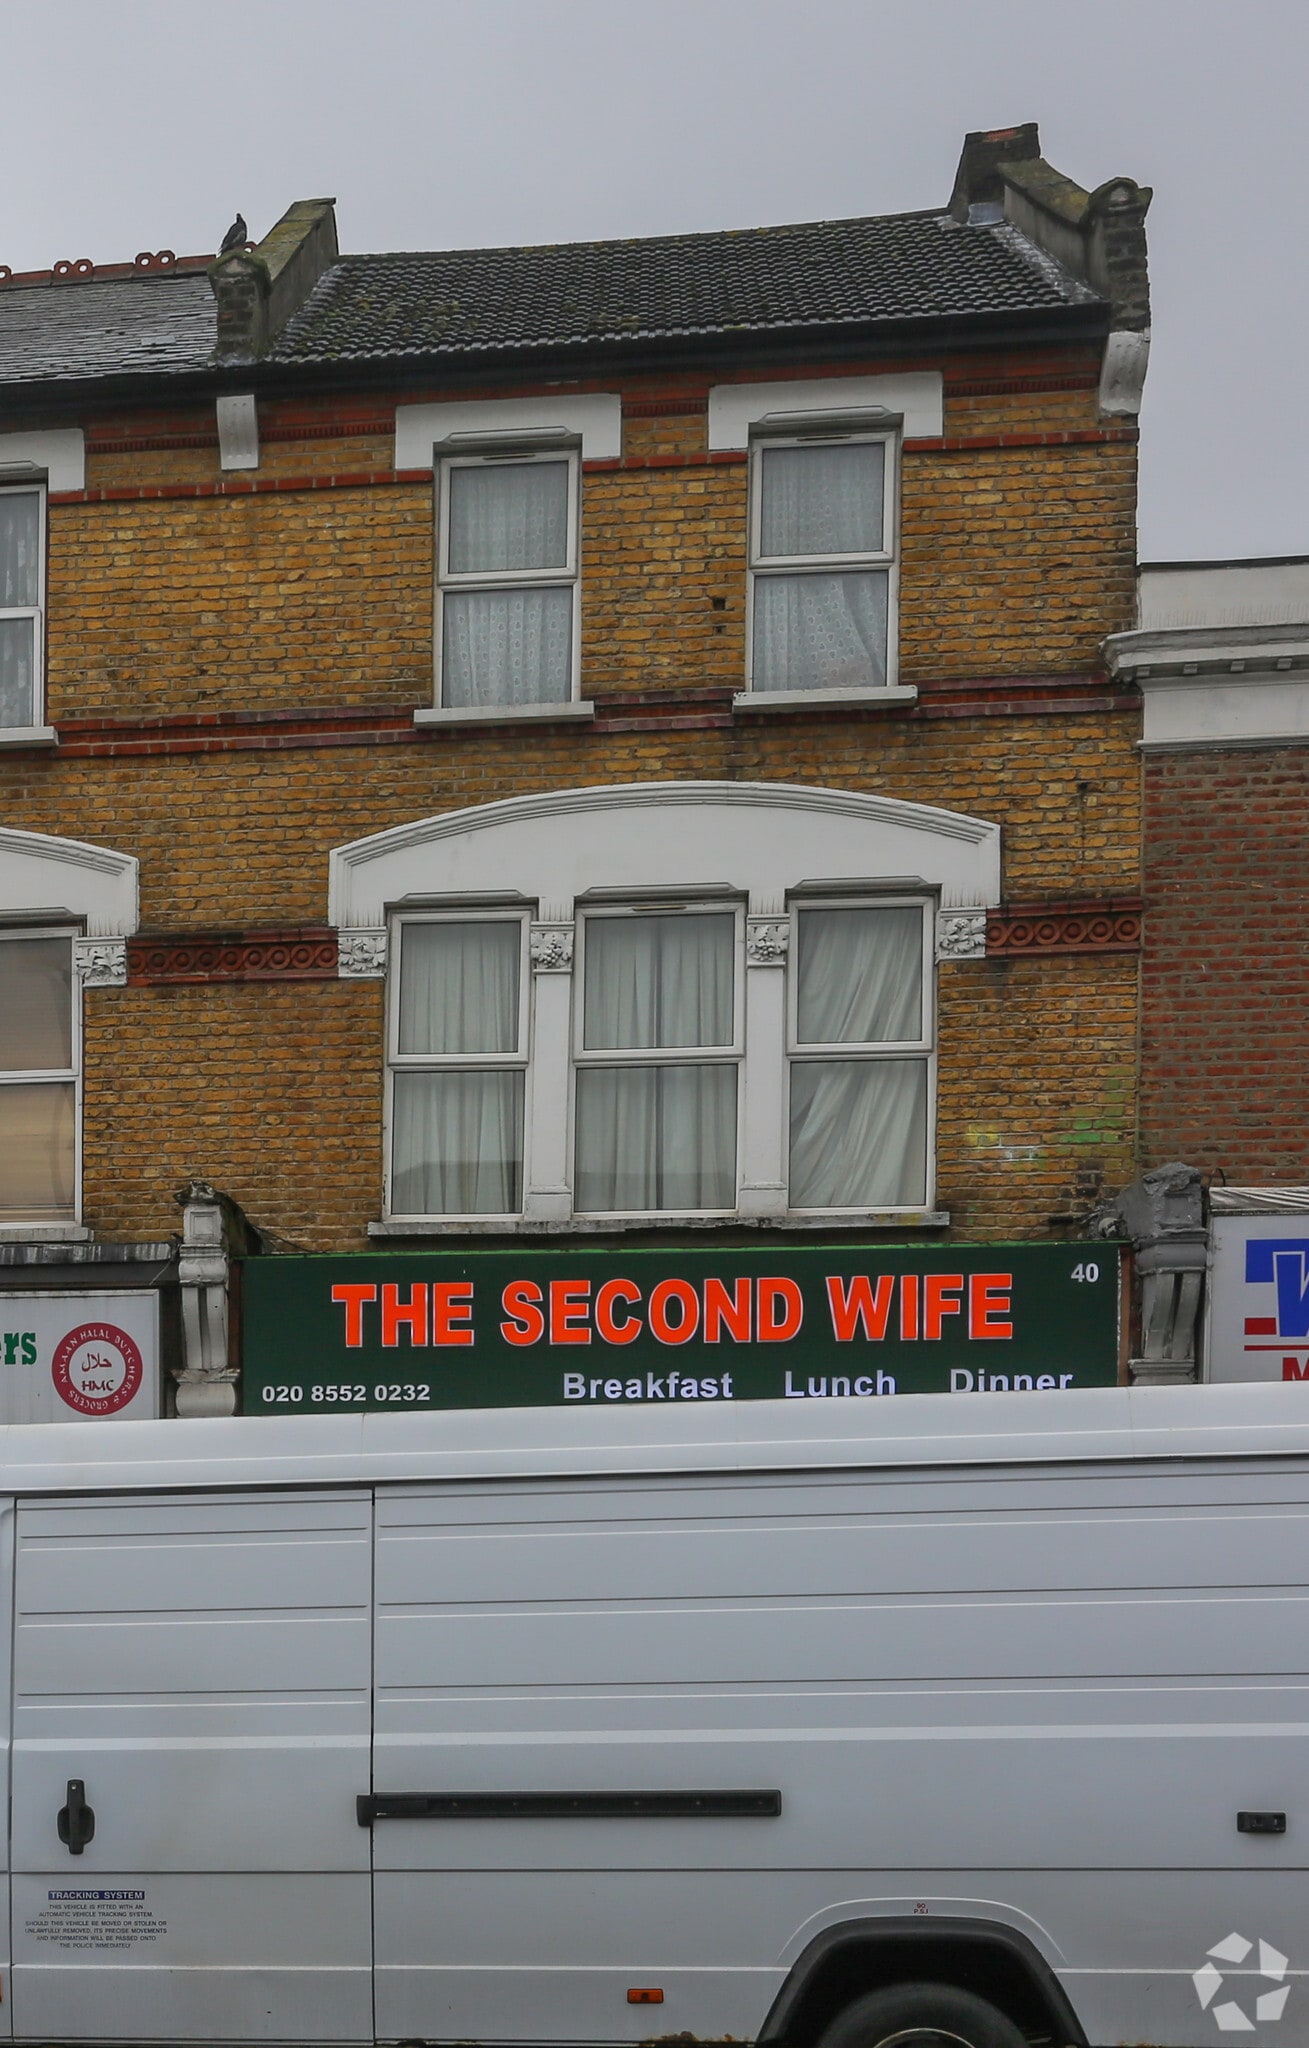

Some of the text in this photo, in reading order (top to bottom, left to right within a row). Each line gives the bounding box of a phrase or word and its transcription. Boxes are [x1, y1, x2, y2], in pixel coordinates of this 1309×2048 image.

[1071, 1263, 1099, 1282] 40
[331, 1273, 1013, 1347] THE SECOND WIFE
[79, 1328, 110, 1340] HALAL
[0, 1331, 37, 1365] rs
[81, 1352, 112, 1372] حلال
[114, 1335, 136, 1397] BUTCHERS
[81, 1380, 114, 1391] HMC
[262, 1384, 430, 1401] 020 8552 0232
[563, 1368, 1073, 1399] Breakfast Lunch Dinner
[68, 1390, 109, 1410] GROCERS
[50, 1891, 143, 1899] TRACKING SYSTEM
